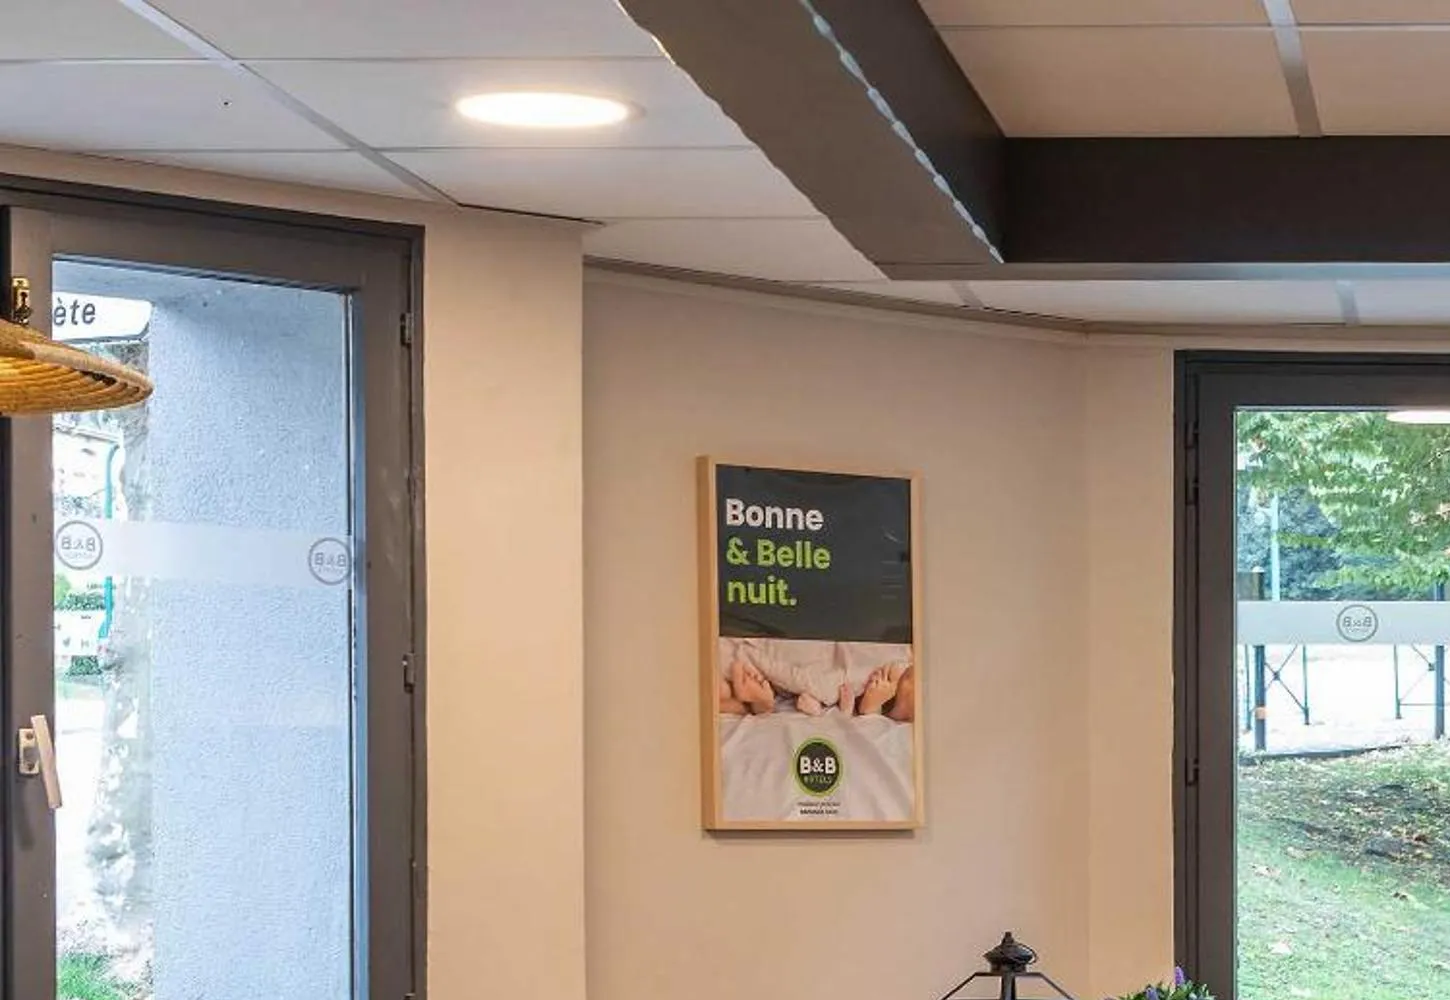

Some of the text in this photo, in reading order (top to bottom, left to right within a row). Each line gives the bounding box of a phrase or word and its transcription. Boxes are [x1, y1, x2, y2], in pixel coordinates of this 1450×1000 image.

[53, 296, 96, 326] ète
[725, 498, 824, 531] Bonne
[726, 537, 831, 569] & Belle
[727, 575, 798, 606] nuit.
[799, 756, 836, 774] B&B
